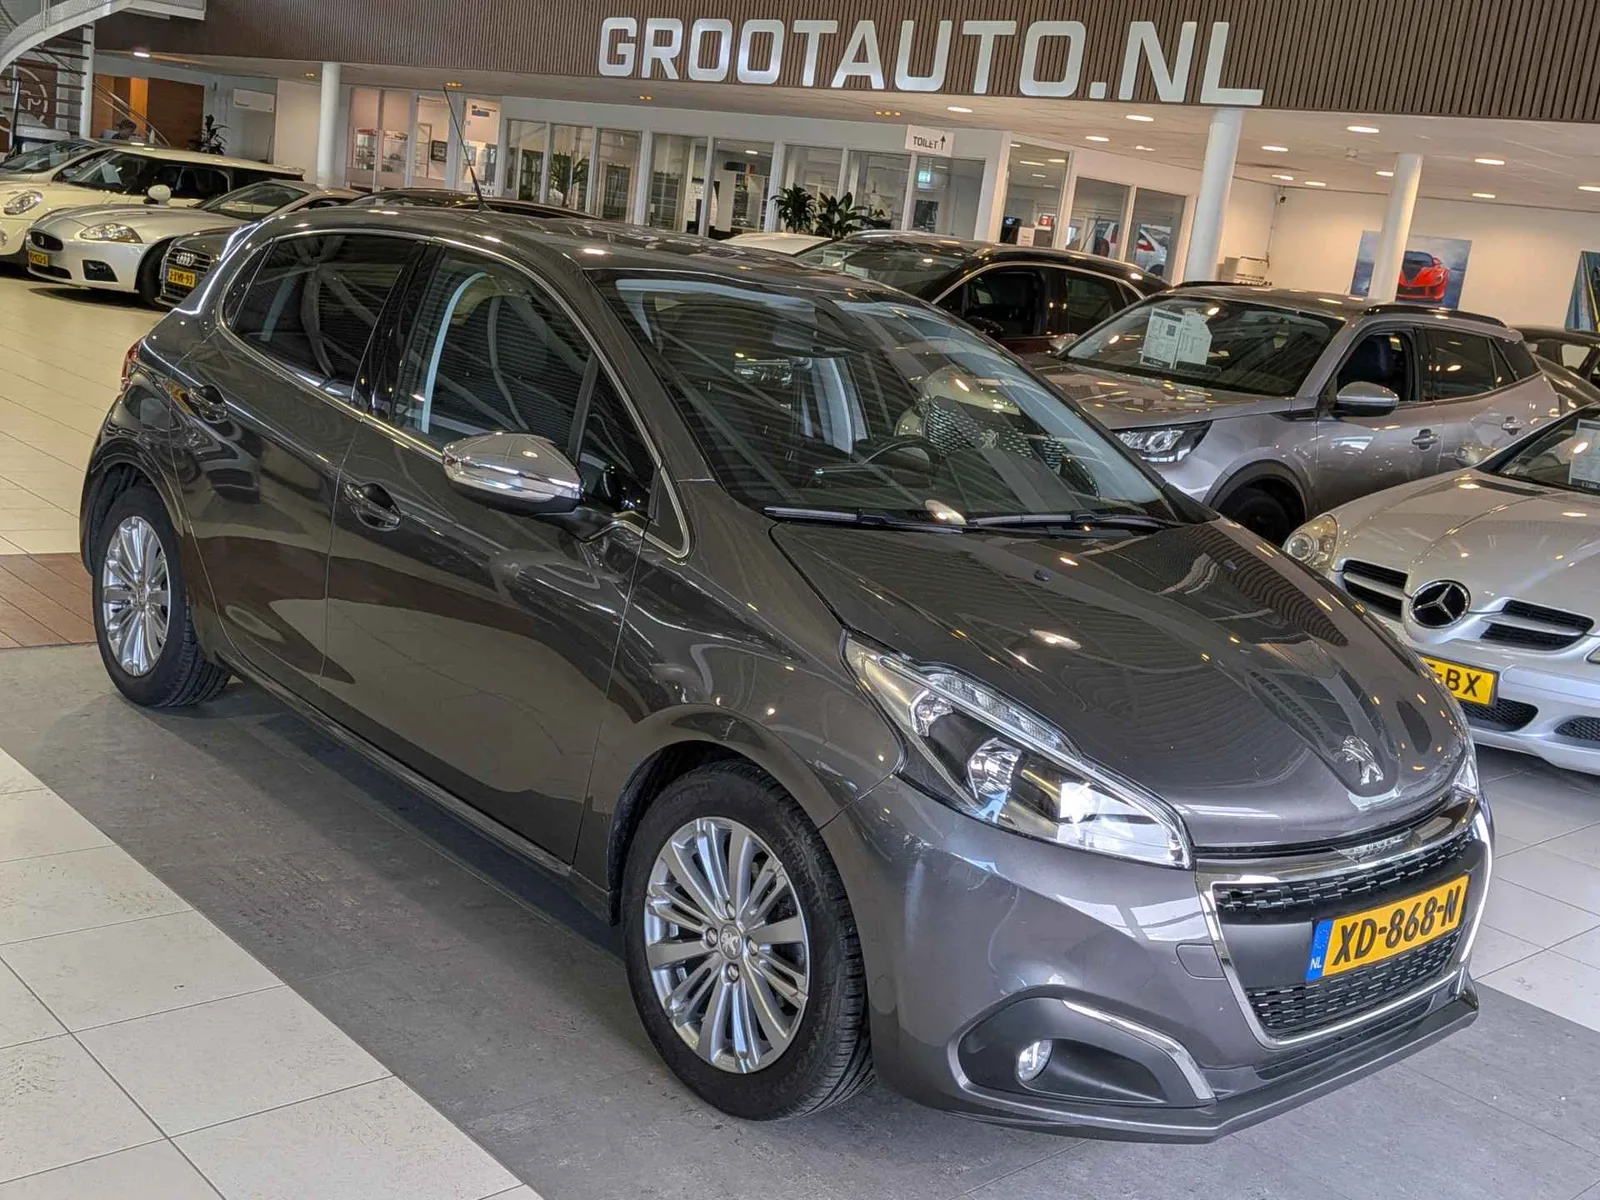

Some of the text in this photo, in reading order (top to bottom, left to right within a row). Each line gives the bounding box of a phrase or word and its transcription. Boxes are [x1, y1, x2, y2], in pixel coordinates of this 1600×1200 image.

[599, 17, 1263, 106] GROOTAUTO.NL
[912, 135, 939, 149] TOILET
[1332, 885, 1461, 966] XD-868-N
[1310, 957, 1322, 970] NL
